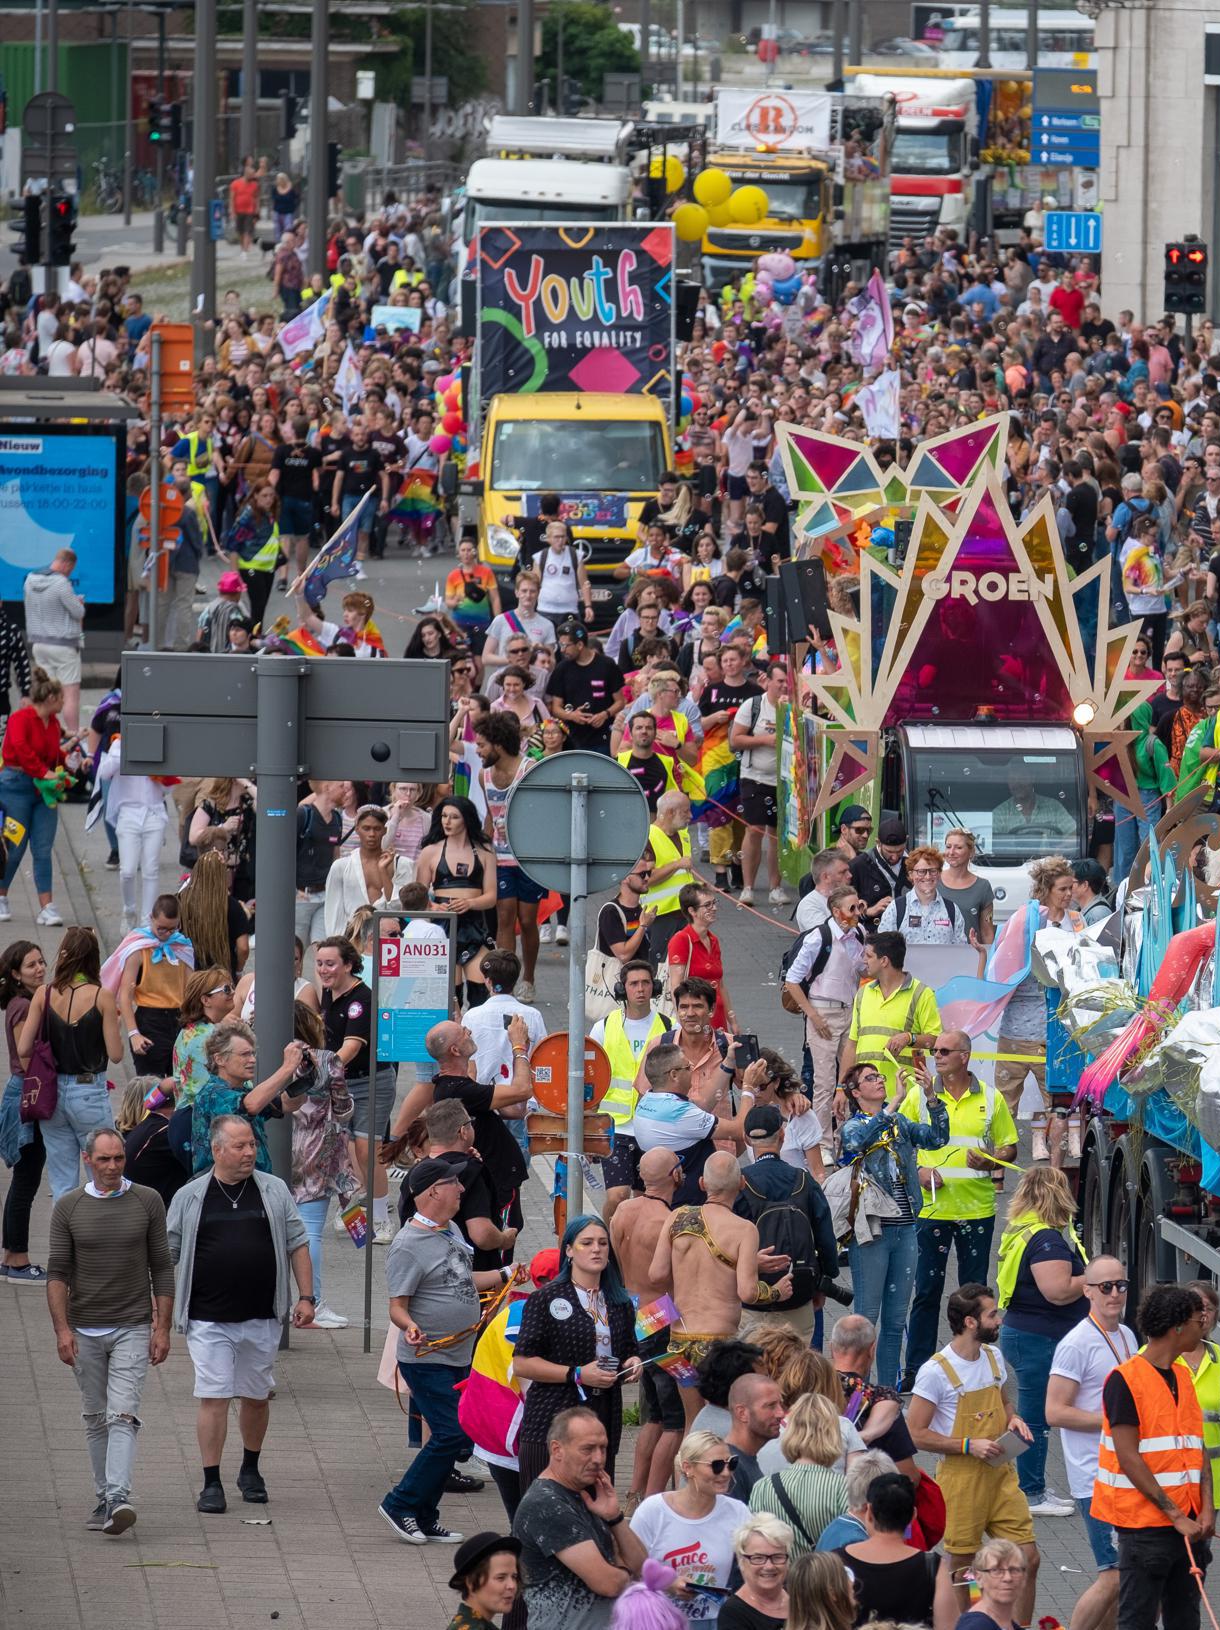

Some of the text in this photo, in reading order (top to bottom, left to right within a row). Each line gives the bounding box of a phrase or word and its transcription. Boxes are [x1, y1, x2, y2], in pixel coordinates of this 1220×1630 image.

[504, 248, 644, 338] Youth
[543, 331, 643, 349] FOR EQUALITY
[926, 570, 1054, 606] GROEN
[381, 943, 447, 966] P AN031
